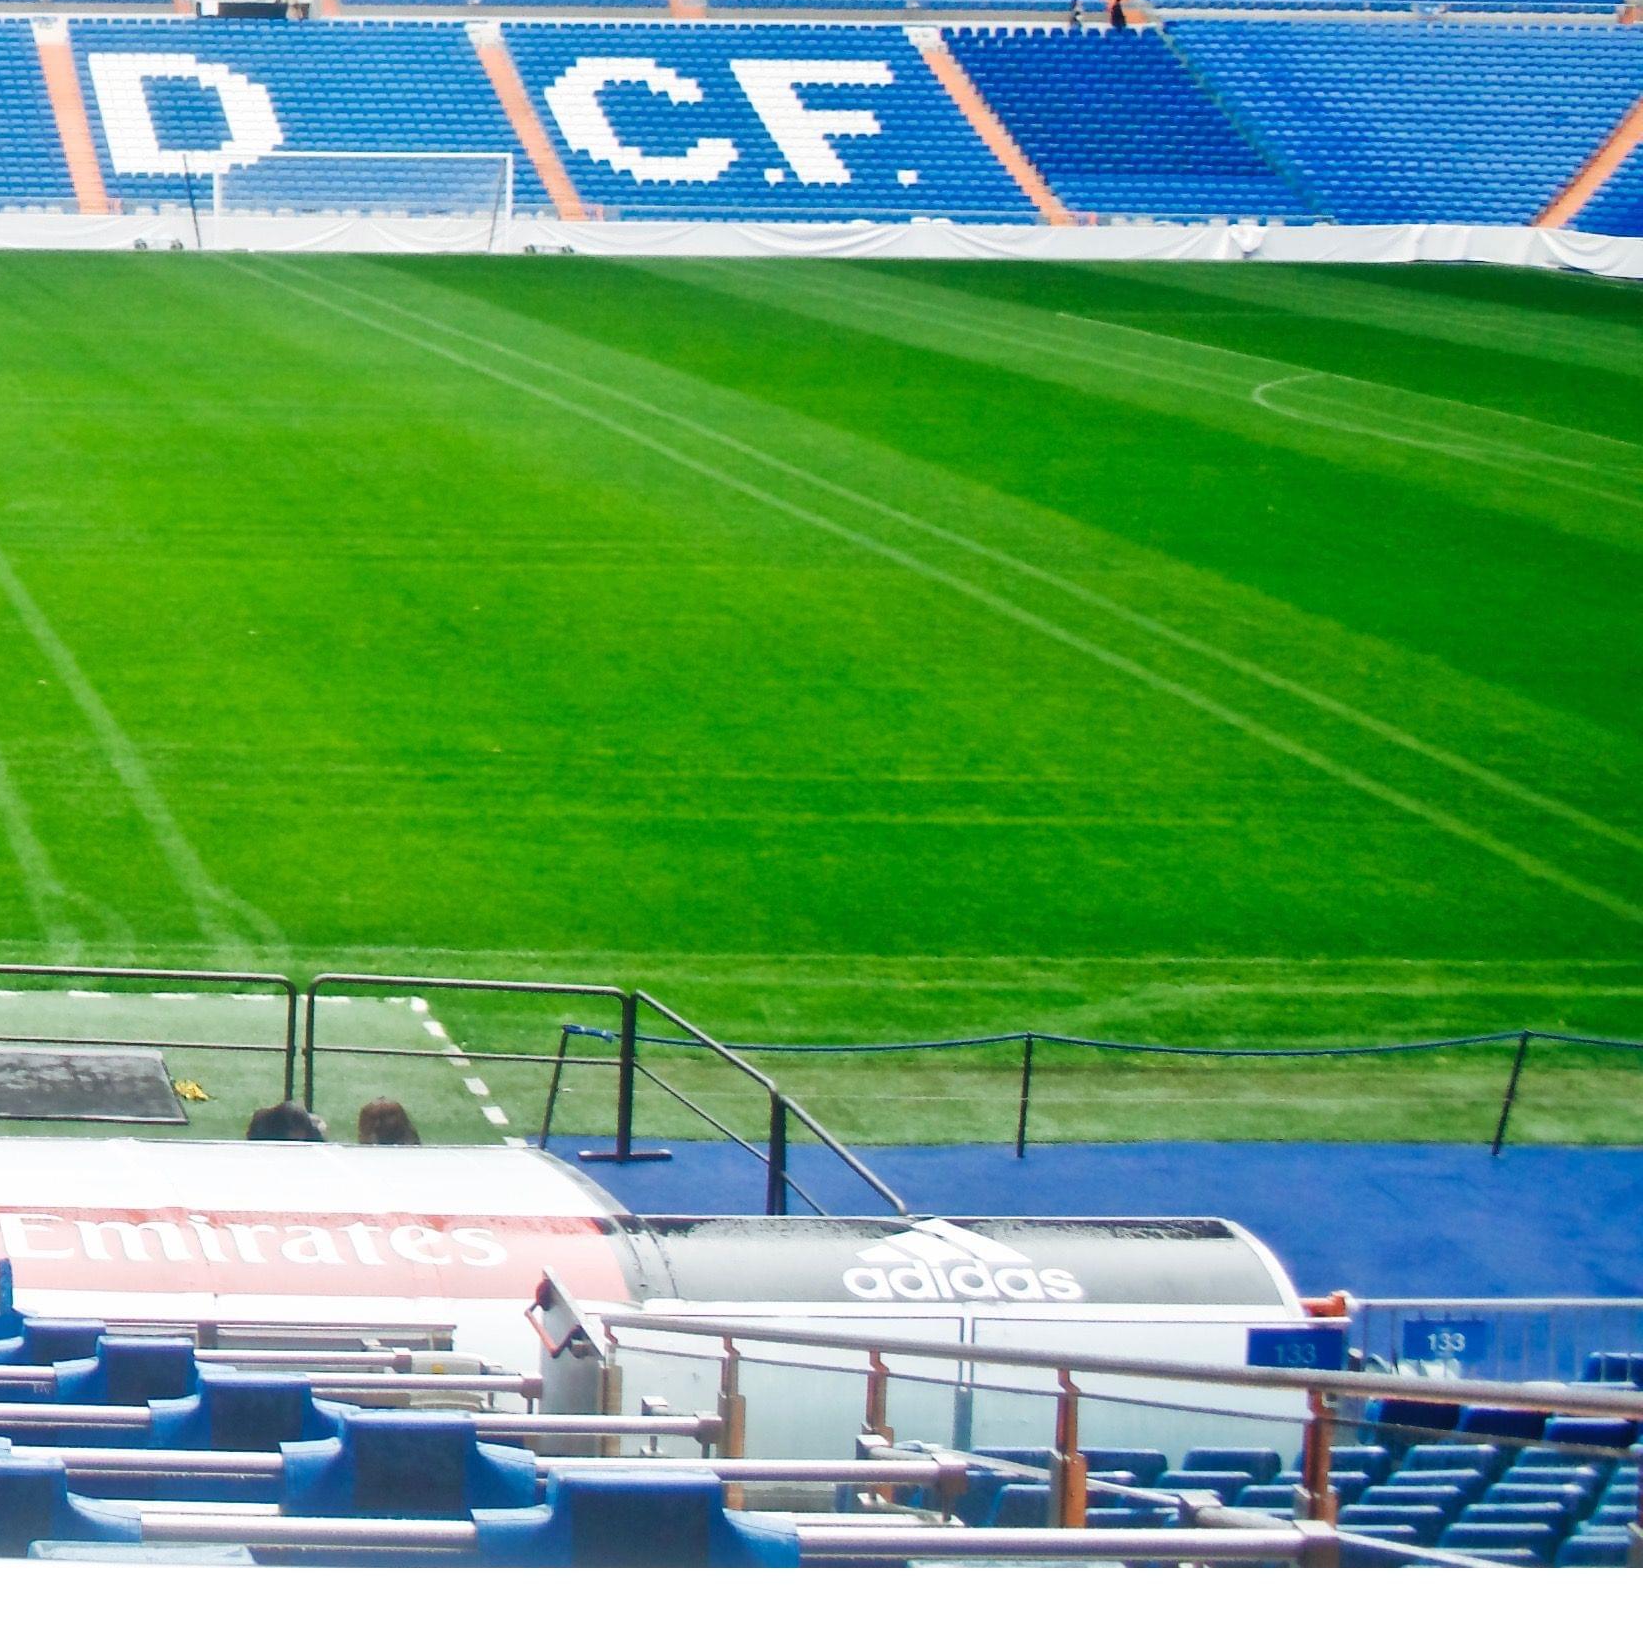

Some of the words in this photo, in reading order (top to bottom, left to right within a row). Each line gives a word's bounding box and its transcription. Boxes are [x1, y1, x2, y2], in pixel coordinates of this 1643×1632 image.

[543, 56, 919, 187] C.F.
[842, 1259, 1085, 1301] adidas
[1275, 1343, 1317, 1364] 133
[1427, 1332, 1467, 1352] 133
